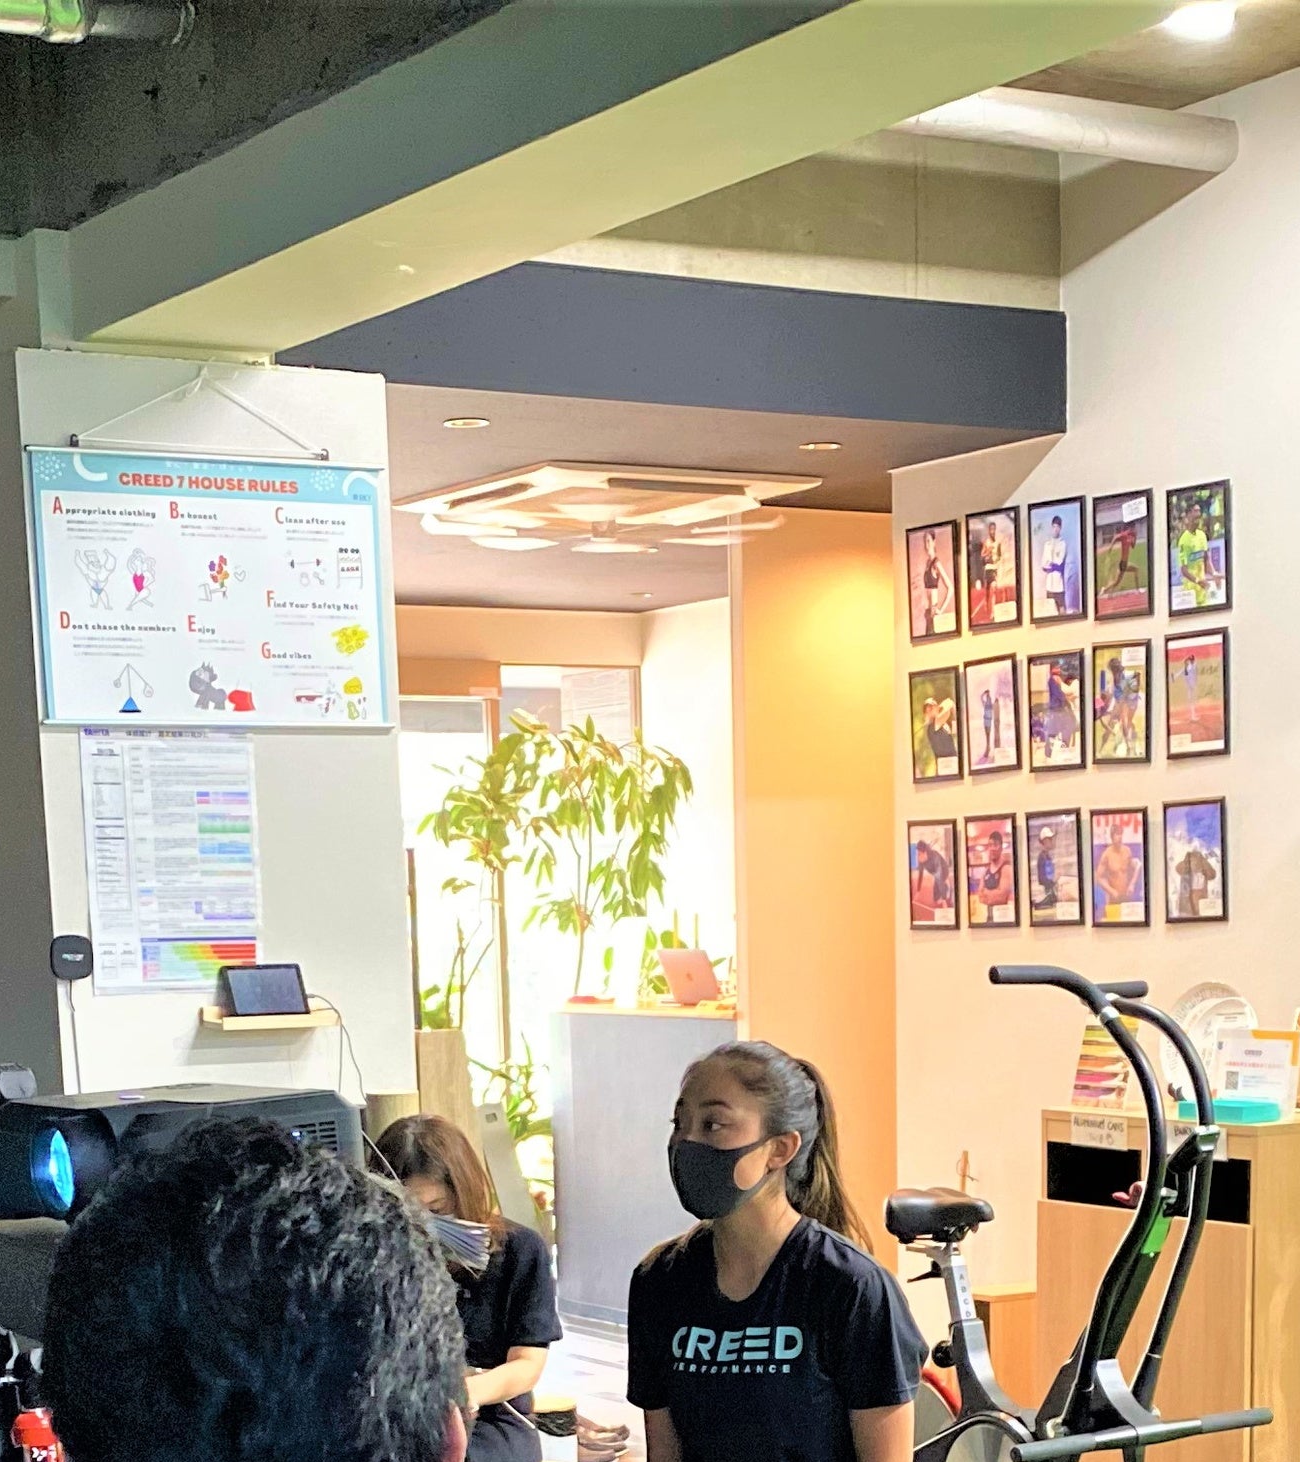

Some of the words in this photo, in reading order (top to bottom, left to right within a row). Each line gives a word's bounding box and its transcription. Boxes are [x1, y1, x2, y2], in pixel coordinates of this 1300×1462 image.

[118, 472, 174, 488] CREED
[177, 475, 185, 489] 7
[188, 476, 245, 491] HOUSE
[248, 479, 299, 494] RULES
[119, 507, 156, 519] clothing
[305, 516, 329, 526] after
[289, 601, 309, 609] Your
[312, 602, 341, 611] Safety
[91, 623, 118, 631] chase
[671, 1326, 803, 1361] CREED
